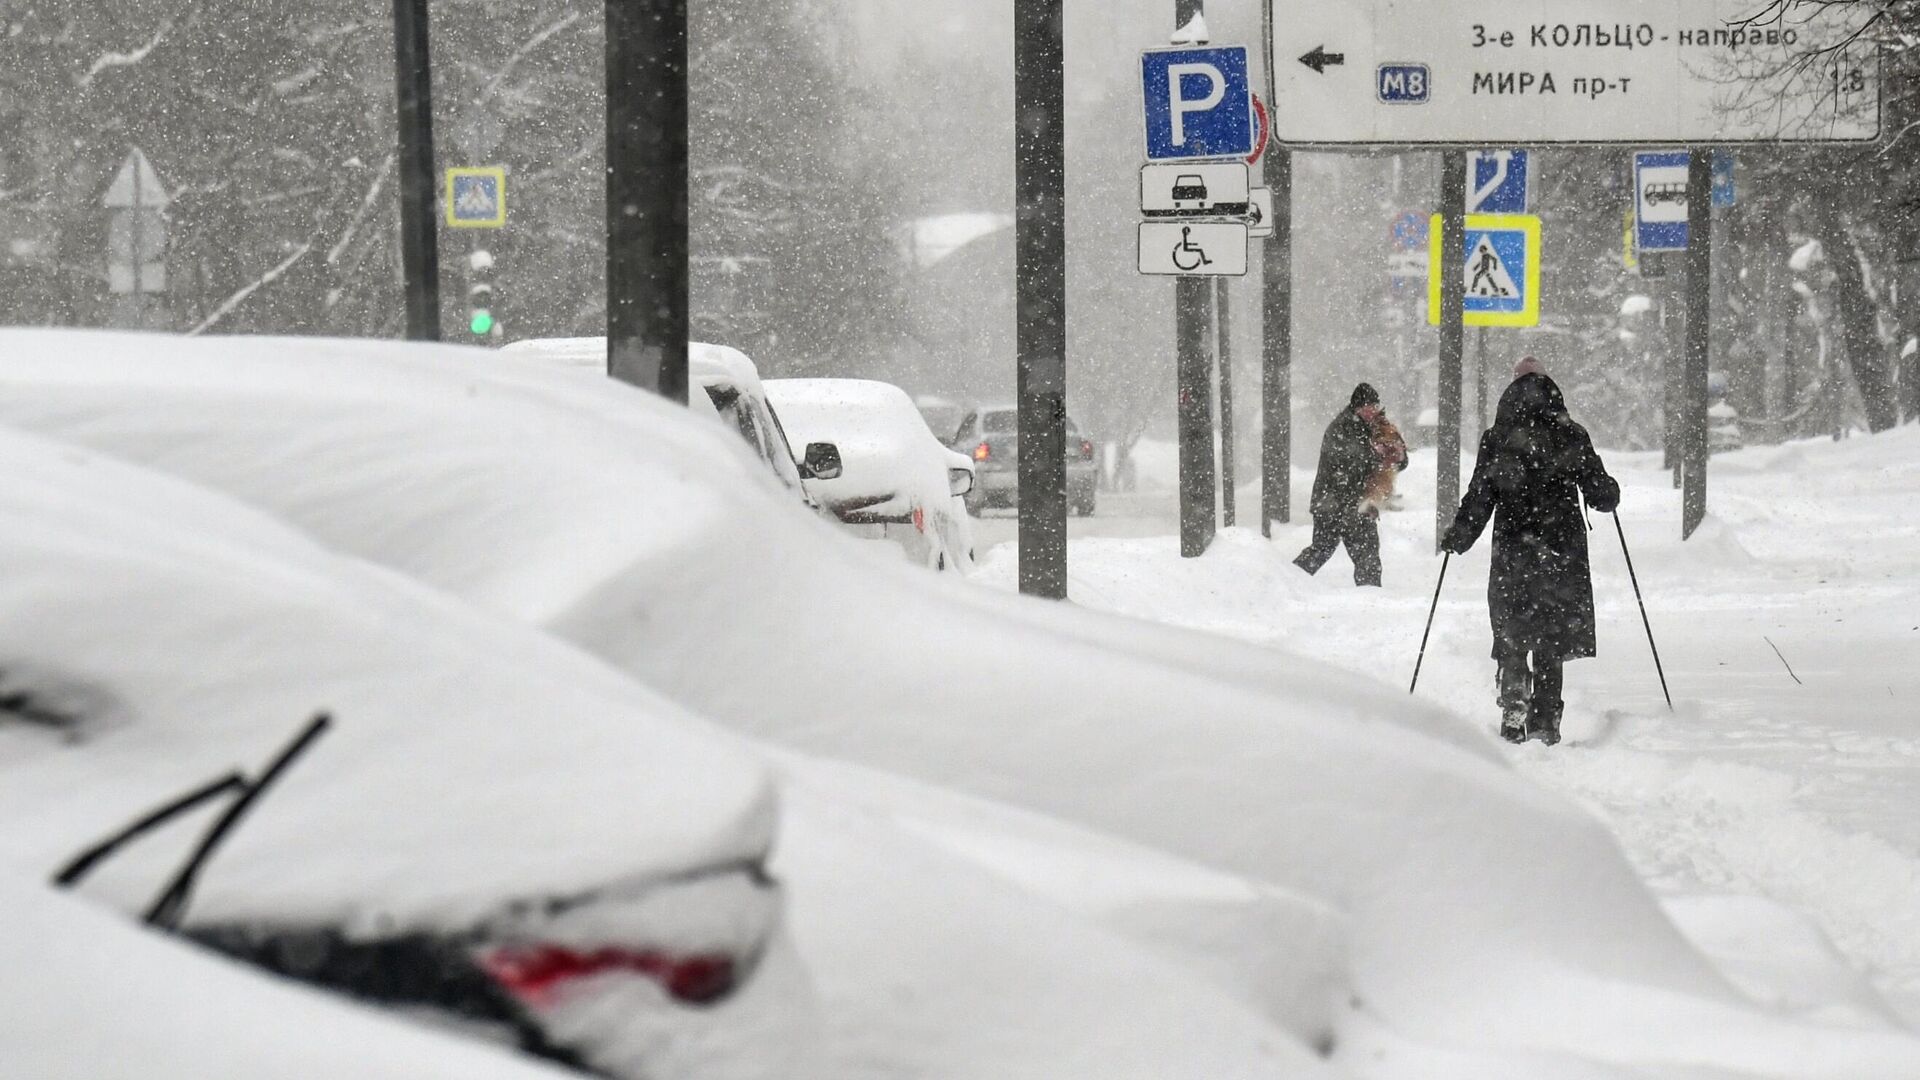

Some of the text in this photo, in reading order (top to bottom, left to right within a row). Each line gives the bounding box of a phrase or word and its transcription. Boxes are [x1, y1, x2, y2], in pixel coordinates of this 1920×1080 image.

[1472, 24, 1514, 47] 3-е
[1531, 24, 1653, 50] КОЛЬЦО
[1679, 28, 1798, 50] направо
[1382, 72, 1424, 95] М8
[1472, 72, 1556, 94] МИРА
[1573, 78, 1631, 100] пр-т
[1168, 63, 1225, 147] P
